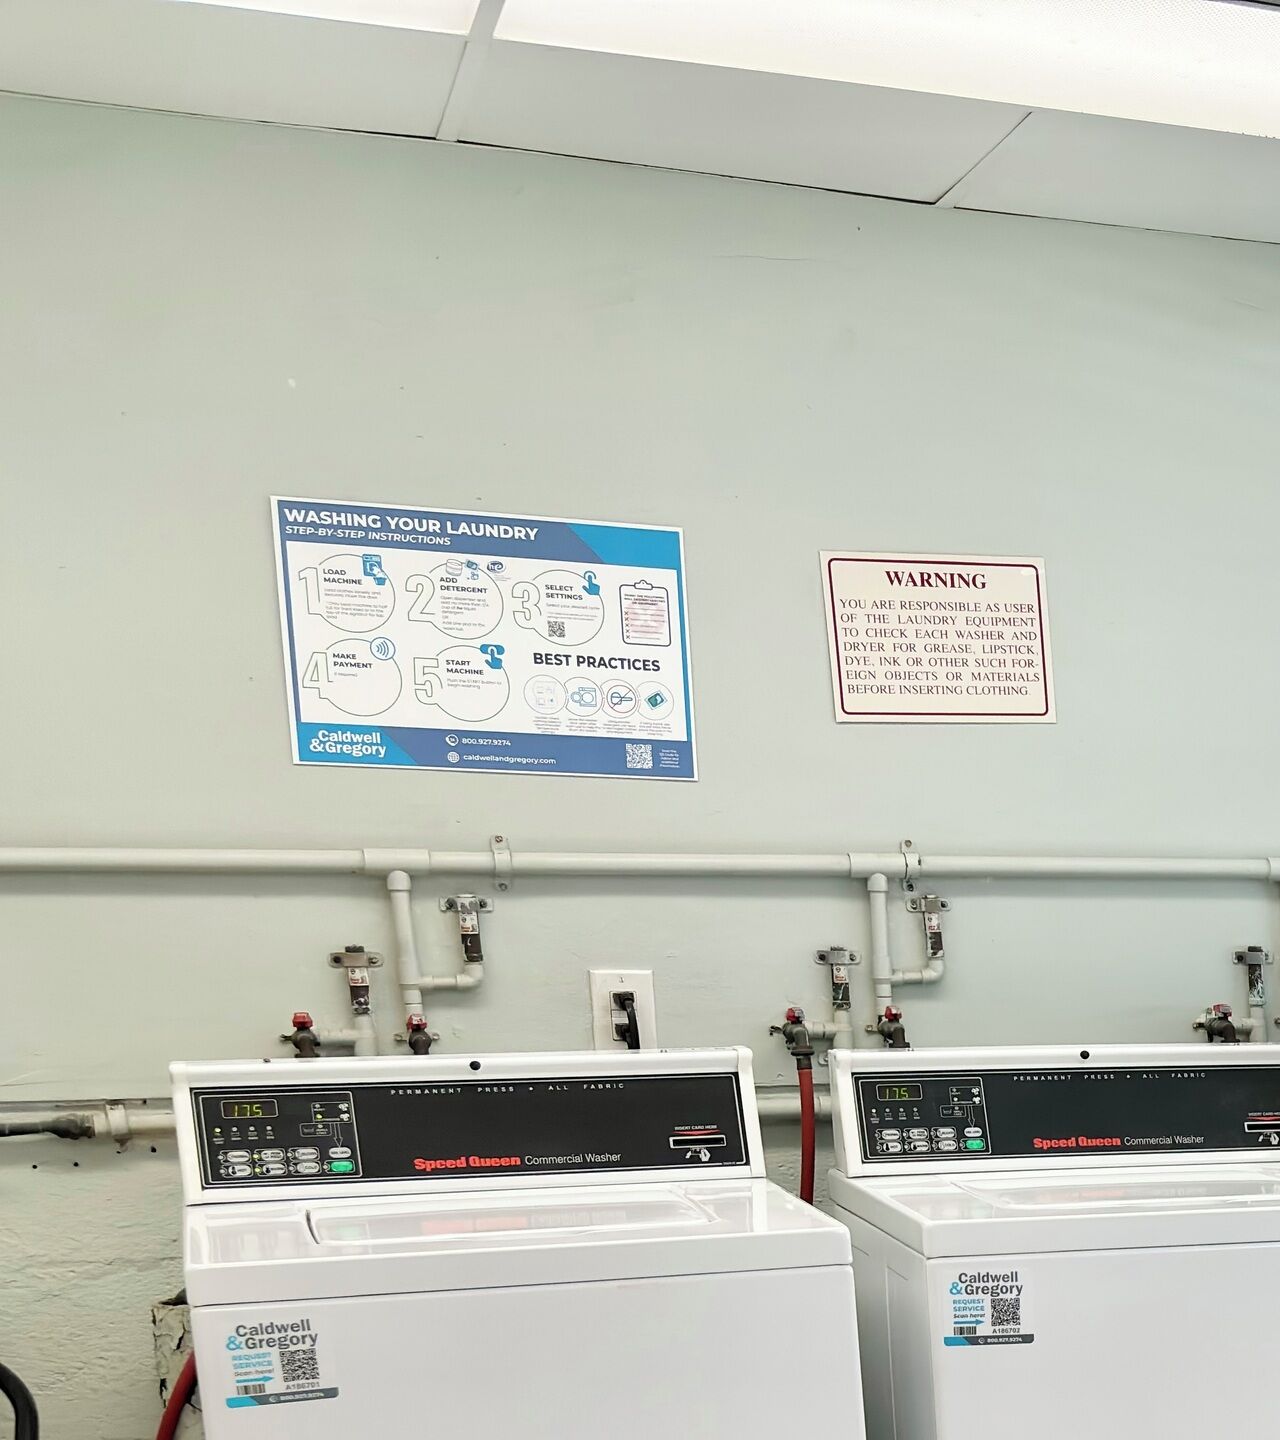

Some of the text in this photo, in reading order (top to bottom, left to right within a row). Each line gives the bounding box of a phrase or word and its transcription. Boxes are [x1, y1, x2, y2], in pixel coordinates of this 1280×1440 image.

[284, 509, 539, 540] WASHING YOUR LAUNDRY
[285, 526, 451, 545] STEP-BY-STEP INSTRUCTIONS
[324, 577, 362, 585] MACHINE
[885, 571, 986, 589] WARNING
[440, 585, 487, 593] DETERGENT
[546, 592, 583, 600] SETTINGS
[840, 599, 1035, 613] YOU ARE RESPONSIBLE AS USER
[840, 613, 1036, 627] OF THE LAUNDRY EQUIPMENT
[841, 627, 1037, 641] TO CHECK EACH WASHER AND
[843, 642, 1039, 656] DRYER FOR GREASE, LIPSTICK,
[334, 661, 373, 669] PAYMENT
[533, 653, 660, 671] BEST PRACTICES
[845, 656, 1039, 668] DYE, INK OR OTHER SUCH FOR-
[846, 670, 1040, 682] EIGN OBJECTS OR MATERIALS
[847, 684, 1031, 696] BEFORE INSERTING CLOTHING.
[318, 730, 381, 743] Caldwell
[462, 738, 511, 746] 800.927.9274
[463, 754, 556, 765] caldwellandgregory.com
[1034, 1135, 1204, 1150] Speed Queen Commercial Washer
[414, 1152, 622, 1172] Speed Queen Commercial Washer
[958, 1271, 1018, 1283] Caldwell
[236, 1319, 311, 1337] Caldwell
[232, 1352, 272, 1361] REQUEST
[233, 1360, 273, 1369] SERVICE
